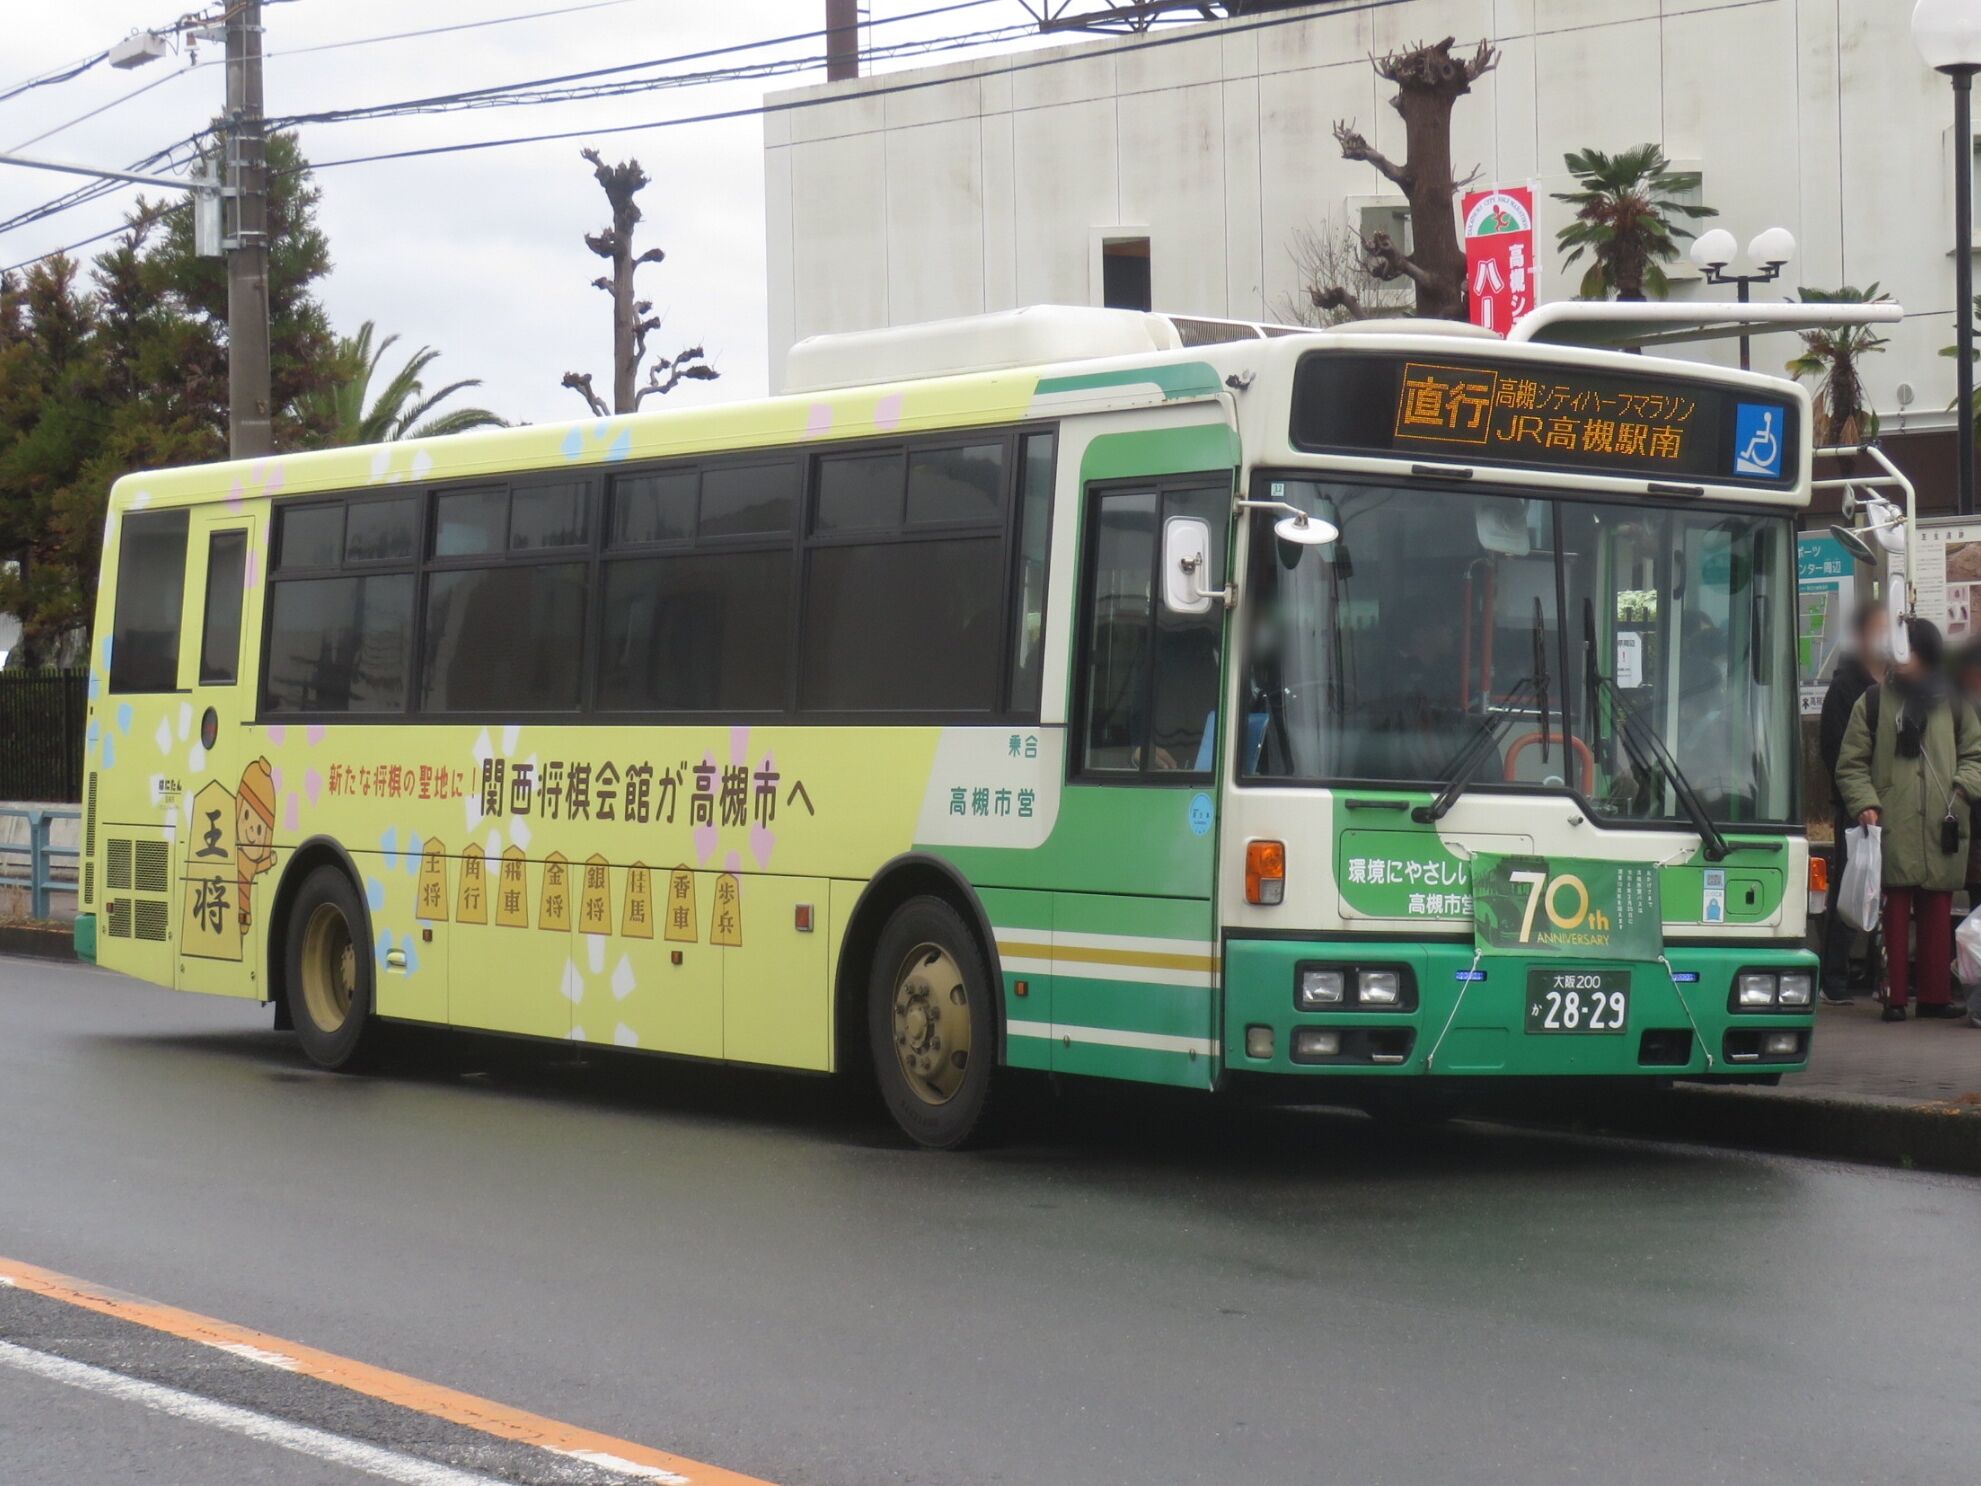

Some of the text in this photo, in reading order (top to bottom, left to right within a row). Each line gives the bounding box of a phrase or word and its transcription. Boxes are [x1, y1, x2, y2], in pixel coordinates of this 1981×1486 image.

[1508, 243, 1526, 325] 高槻シ
[1404, 376, 1490, 428] 直行
[1496, 415, 1684, 459] JR高槻駅南
[1008, 734, 1039, 759] 乗合
[481, 758, 815, 829] 関西将棋会館が高槻市へ
[949, 787, 1036, 817] 高槻市営
[193, 809, 231, 935] 王将
[423, 850, 441, 908] 王将
[463, 854, 481, 910] 角行
[504, 857, 521, 915] 飛車
[546, 863, 565, 918] 金将
[586, 866, 605, 922] 銀将
[672, 875, 690, 930] 香車
[718, 882, 735, 934] 歩兵
[1536, 931, 1610, 946] ANNIVERSARY
[1530, 991, 1626, 1029] か 28-29
